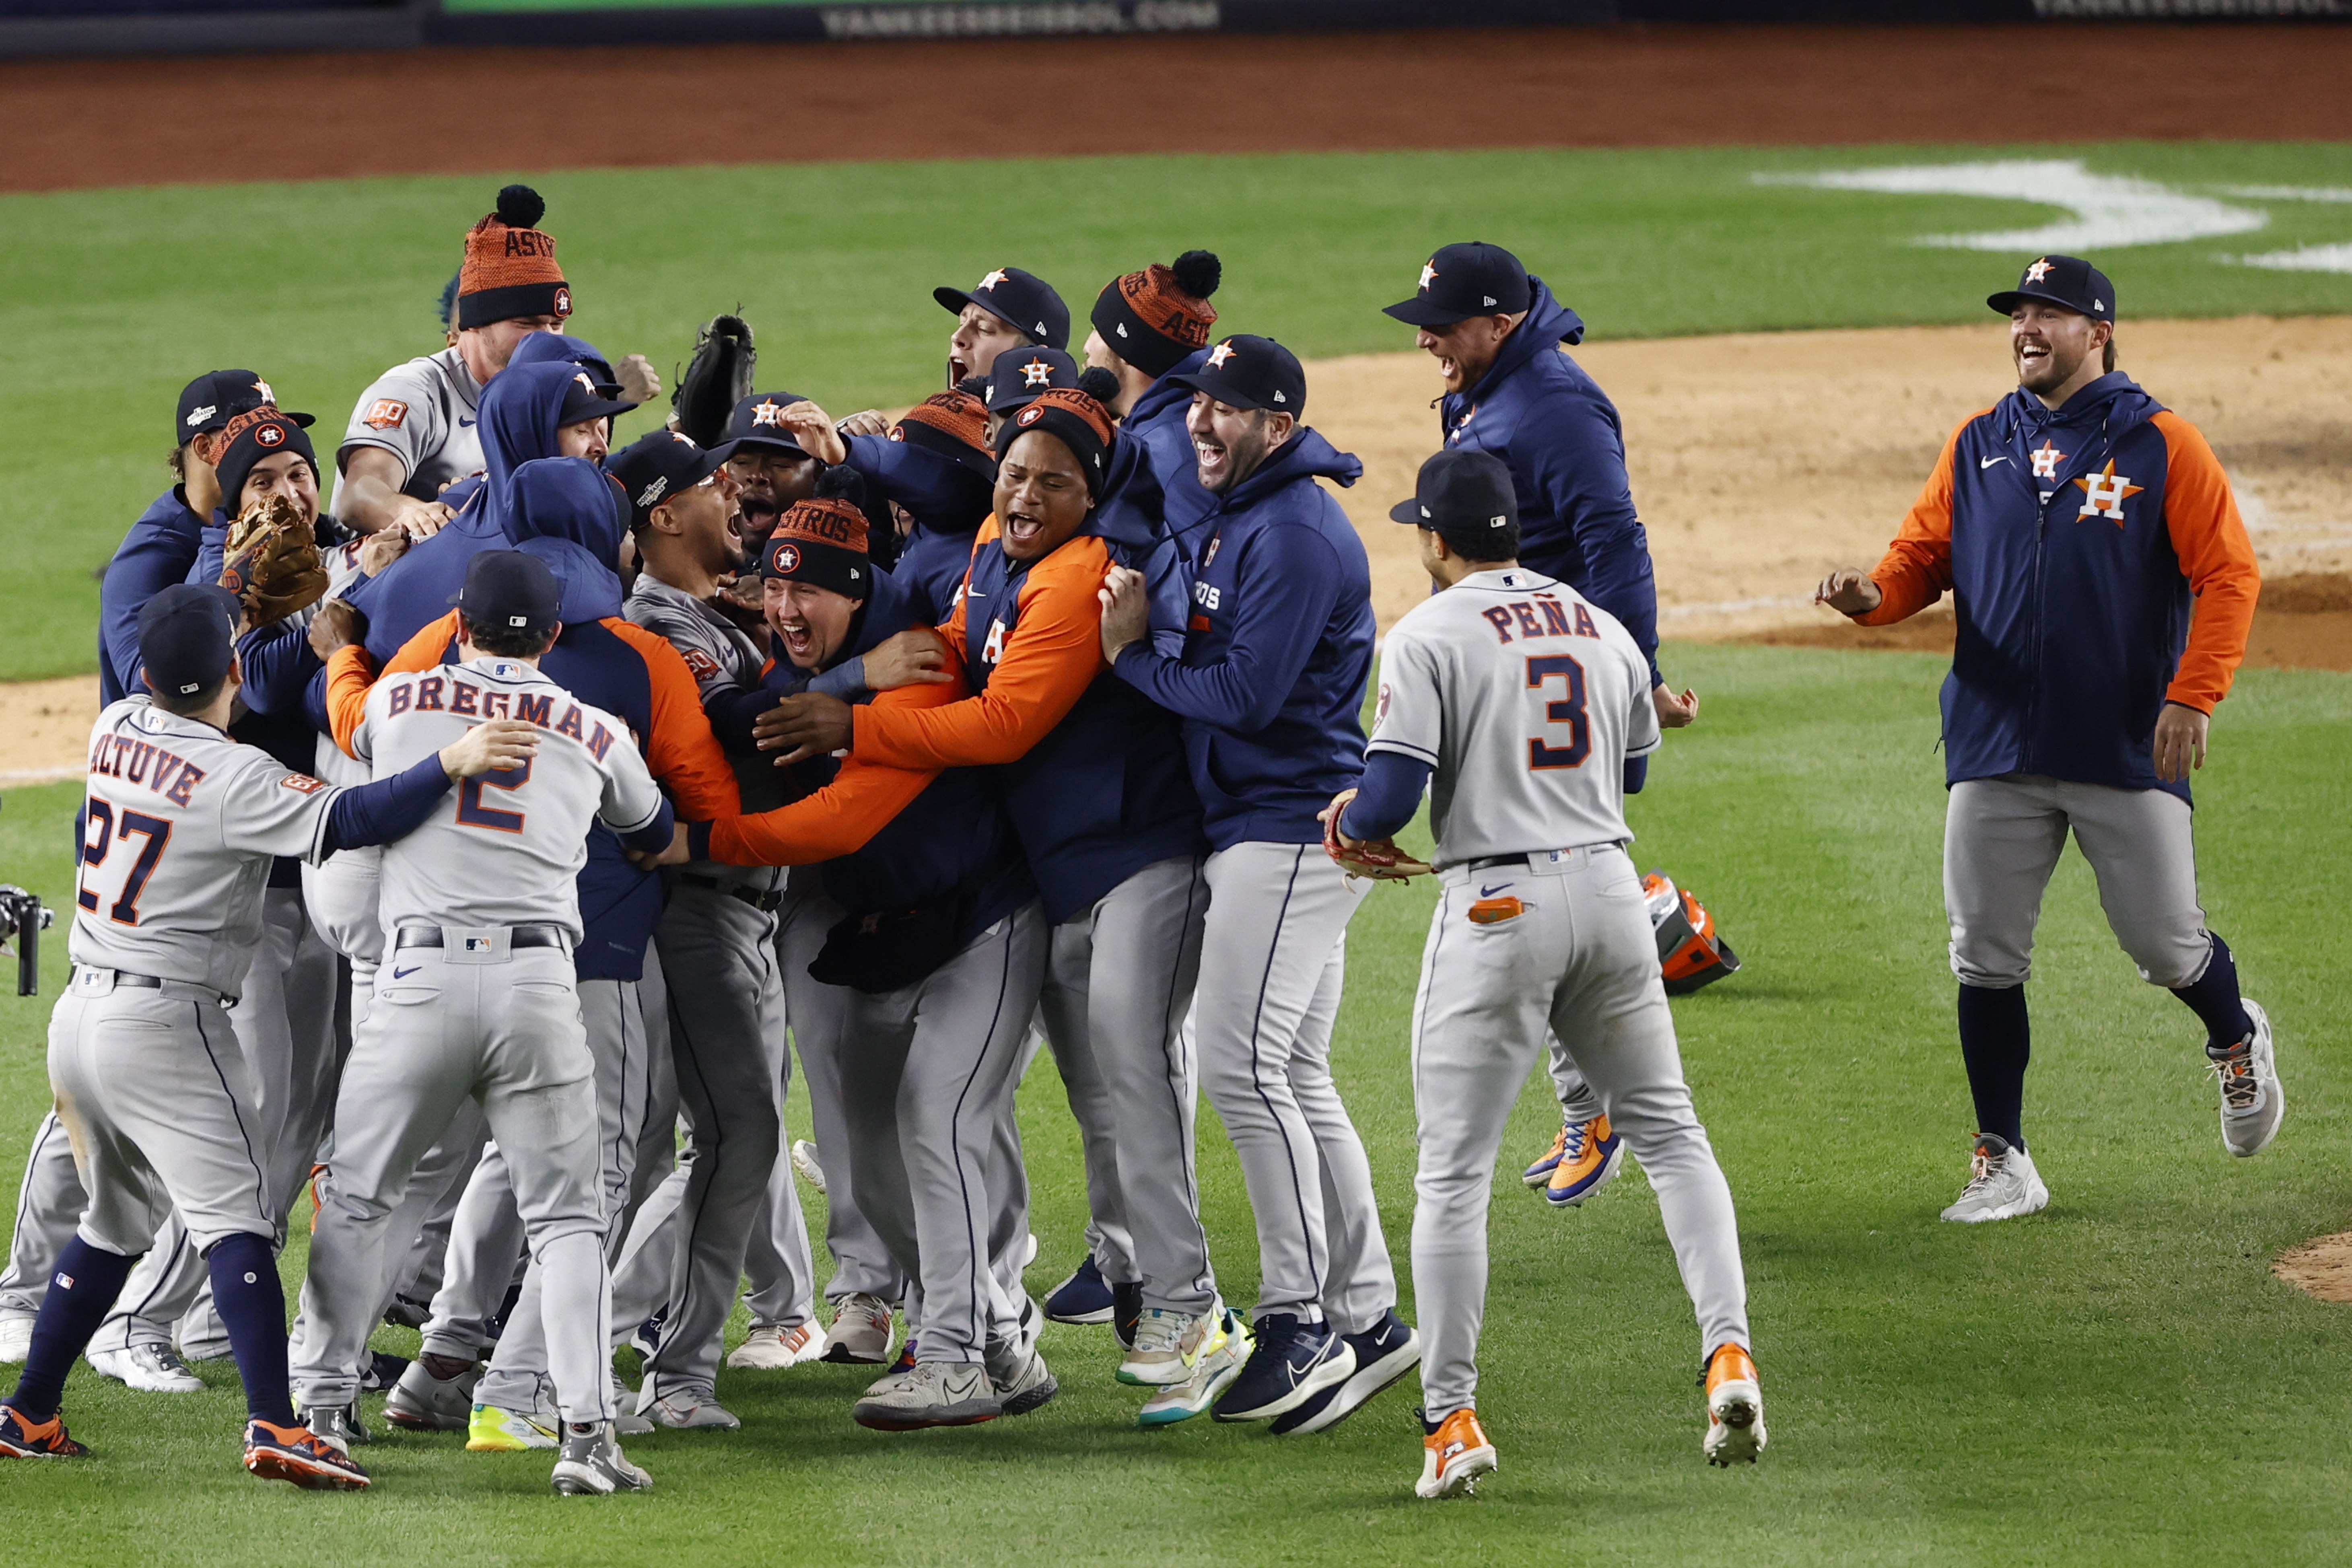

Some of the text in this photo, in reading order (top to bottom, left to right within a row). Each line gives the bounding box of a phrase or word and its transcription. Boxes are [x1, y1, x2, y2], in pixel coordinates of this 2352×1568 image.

[2026, 263, 2050, 281] H
[1208, 344, 1233, 366] H
[1024, 363, 1050, 384] H
[371, 401, 404, 421] 60
[753, 404, 780, 425] H
[638, 478, 666, 506] POSTSEASON
[2079, 473, 2131, 520] H
[1481, 593, 1601, 645] PEÑA
[389, 676, 615, 764] BREGMAN
[1525, 653, 1592, 770] 3
[285, 773, 319, 790] 60
[455, 725, 534, 834] 2
[78, 794, 173, 926] 27
